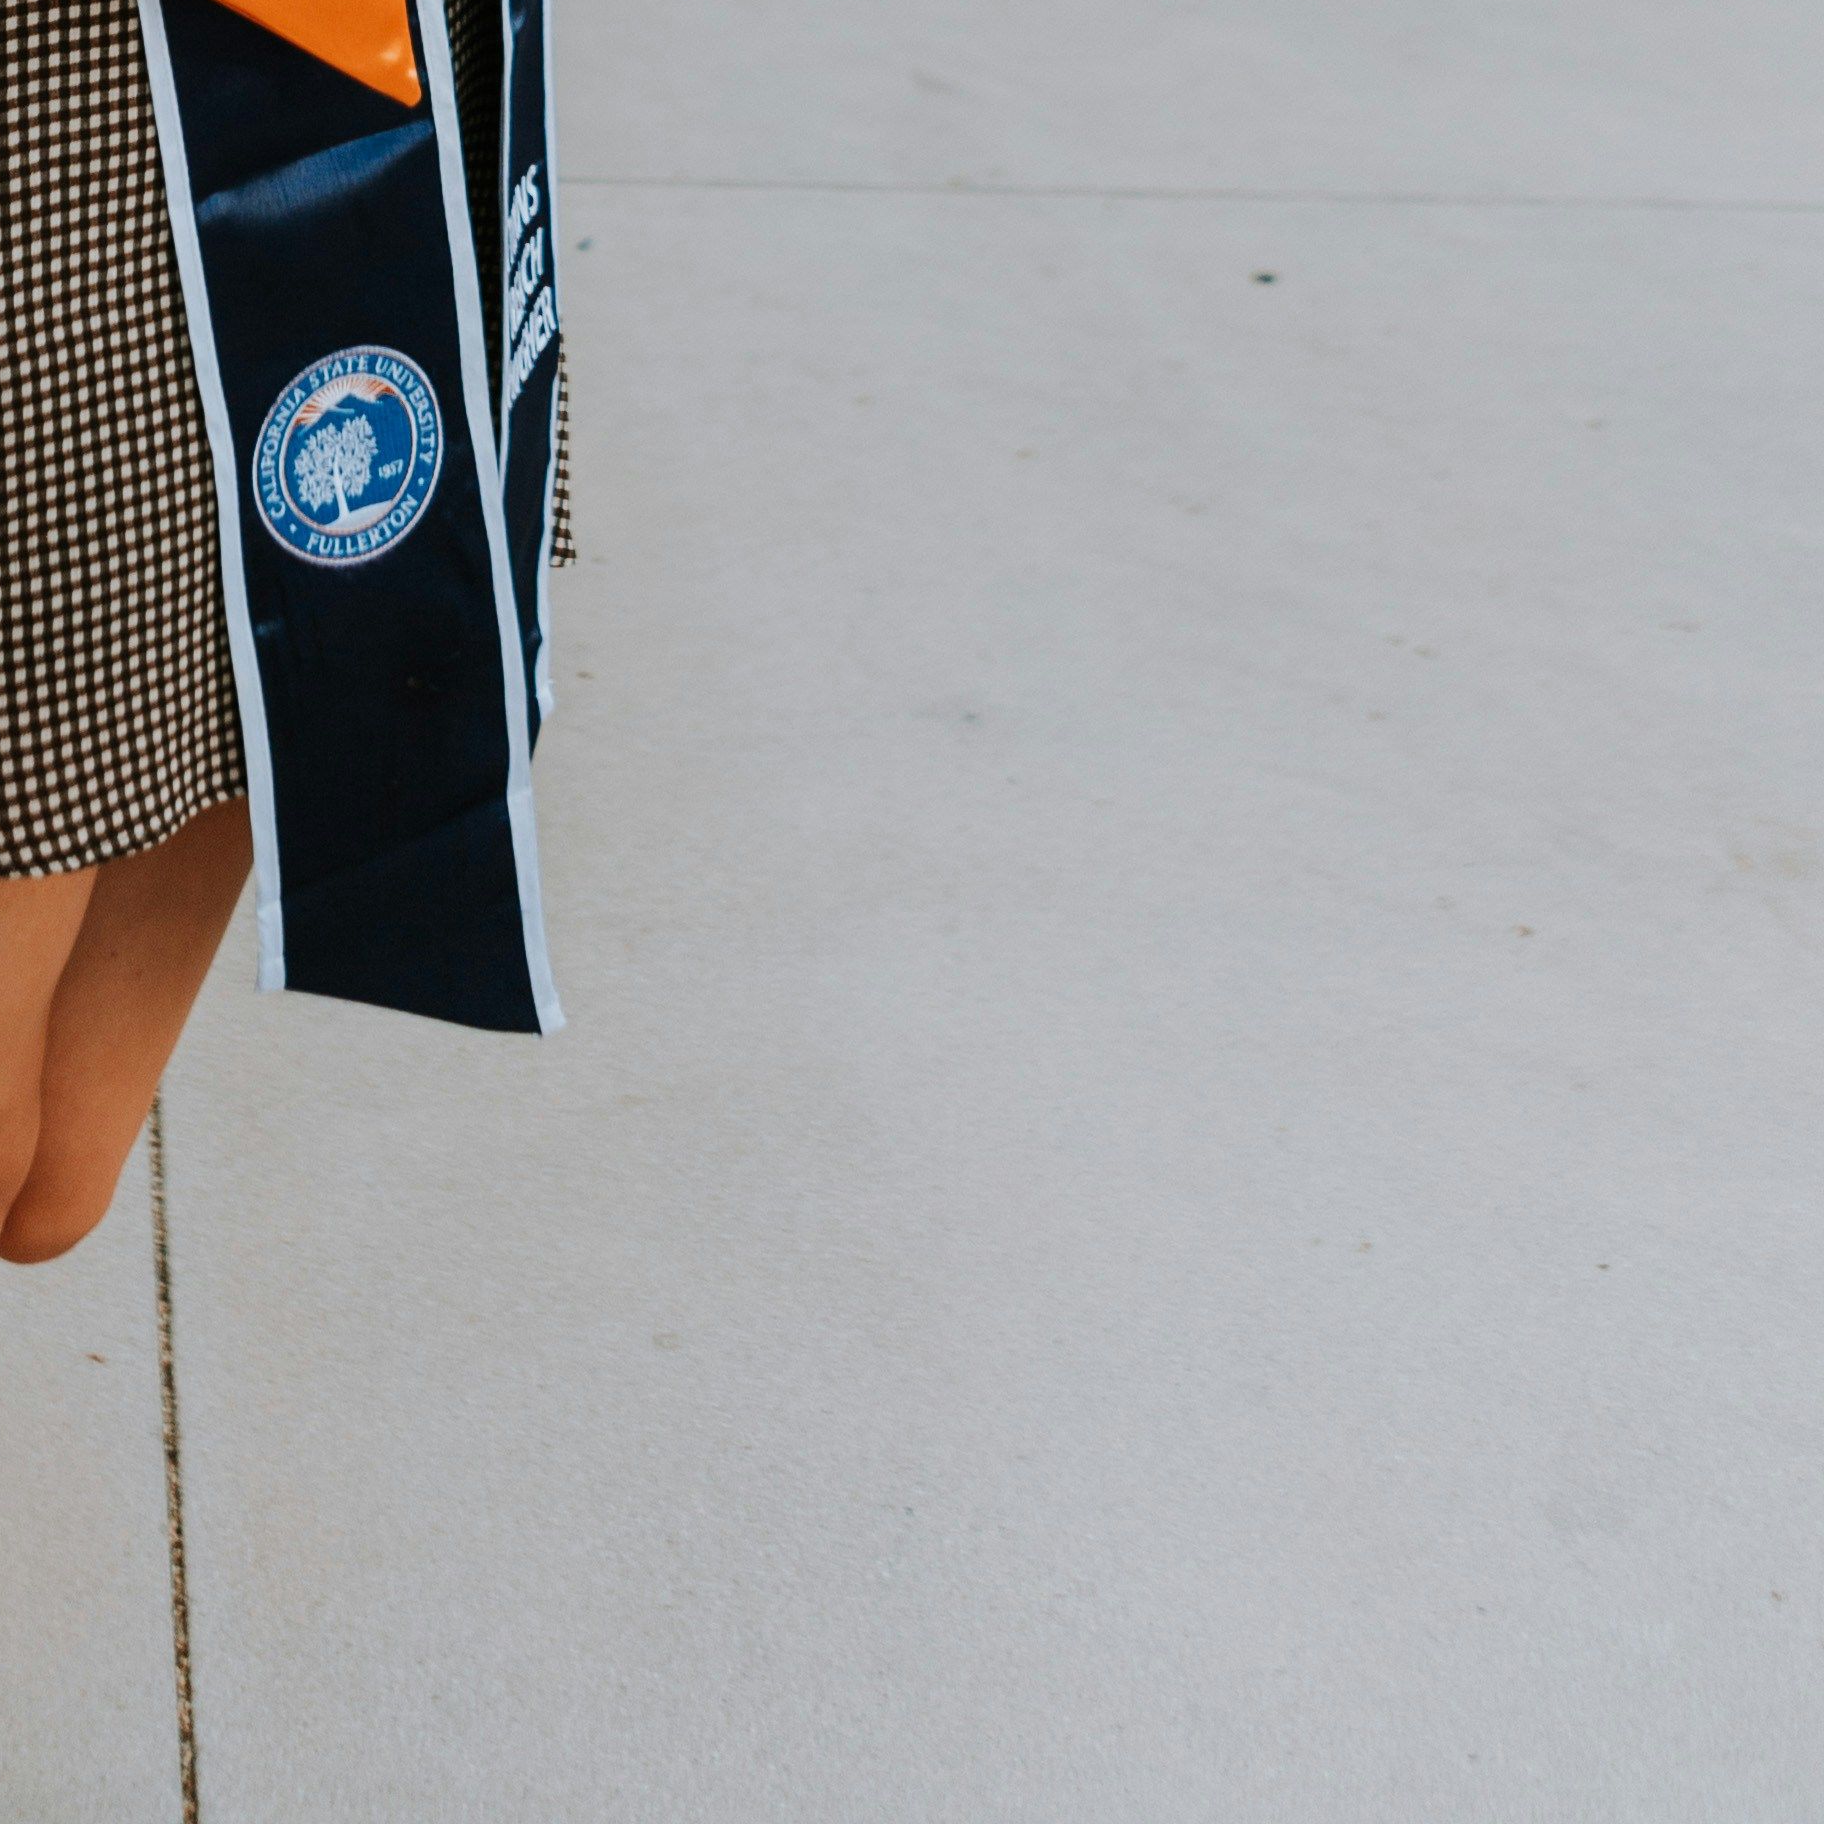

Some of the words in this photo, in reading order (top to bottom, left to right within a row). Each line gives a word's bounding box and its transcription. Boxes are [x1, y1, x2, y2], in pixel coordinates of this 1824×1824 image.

[260, 389, 307, 520] CALIFORNIA
[308, 354, 370, 388] STATE
[375, 355, 436, 467] UNIVERSITY
[306, 493, 418, 556] FULLERTON
